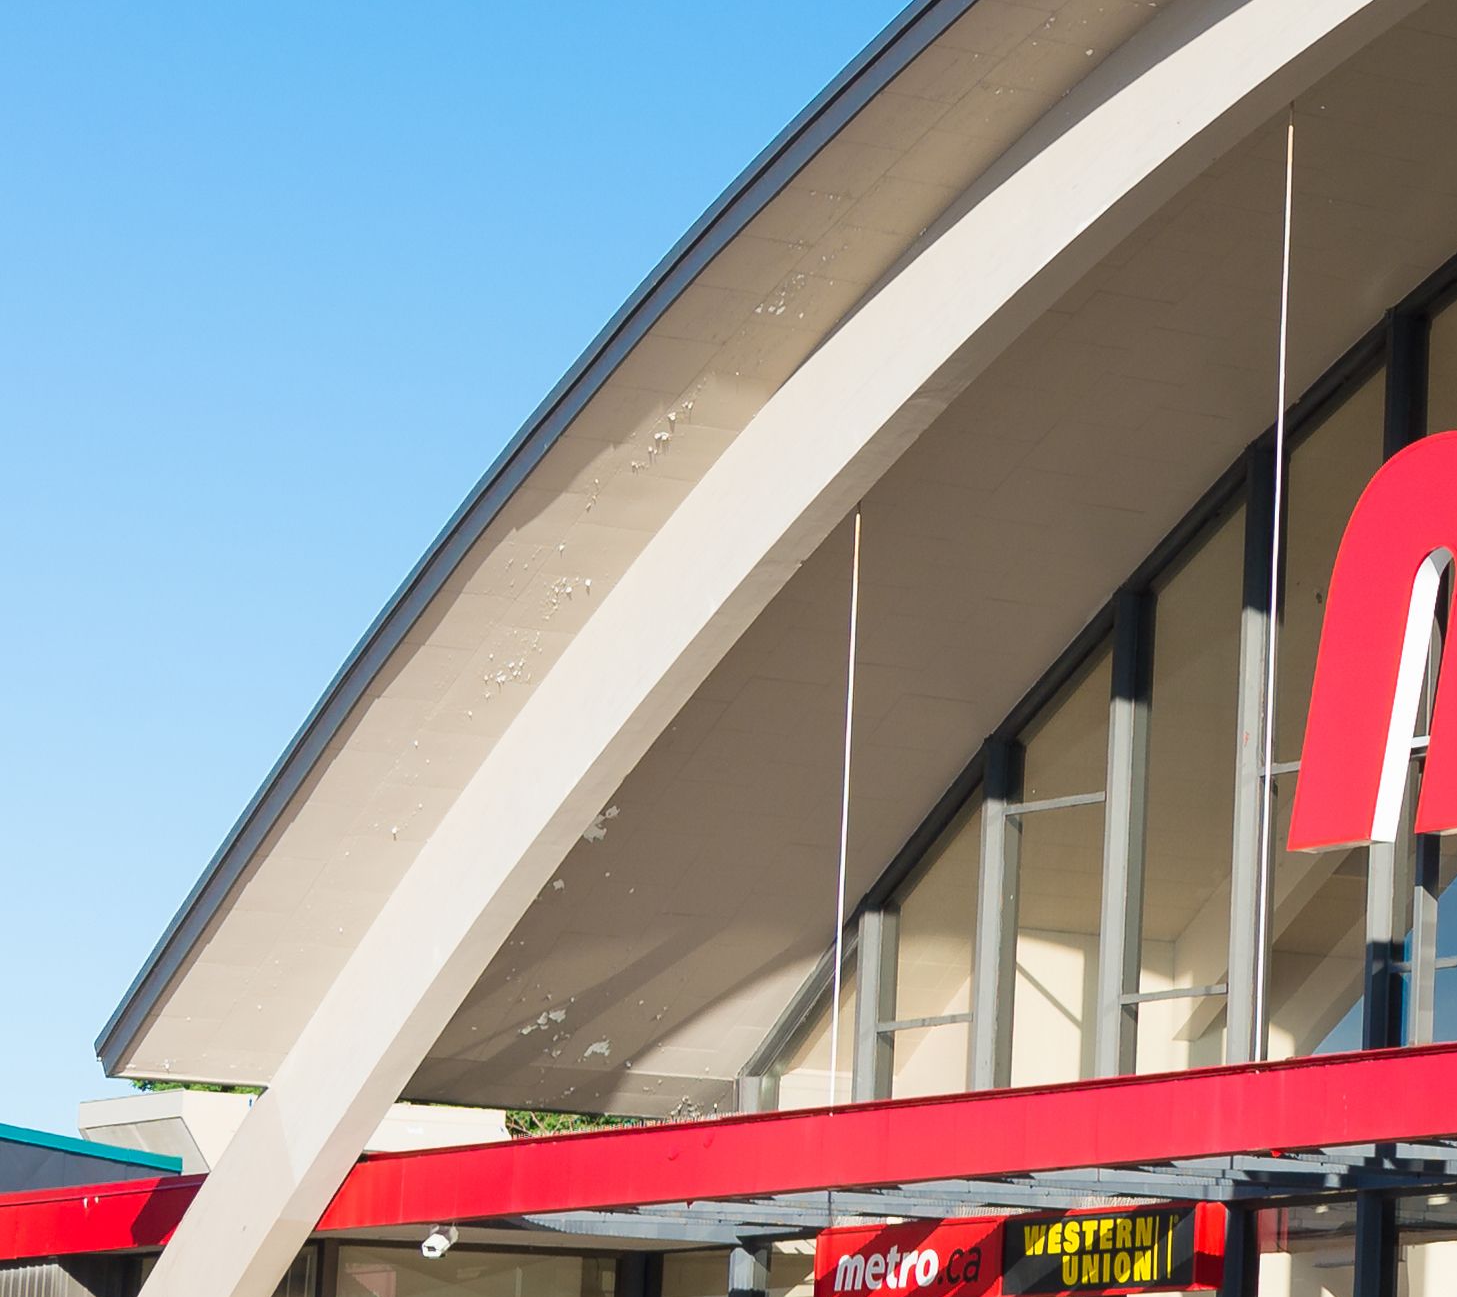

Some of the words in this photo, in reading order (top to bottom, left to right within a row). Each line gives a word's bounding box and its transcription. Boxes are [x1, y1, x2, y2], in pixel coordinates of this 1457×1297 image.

[1024, 1216, 1154, 1257] WESTERN
[834, 1244, 981, 1292] metro.ca
[1062, 1249, 1152, 1286] UNION
